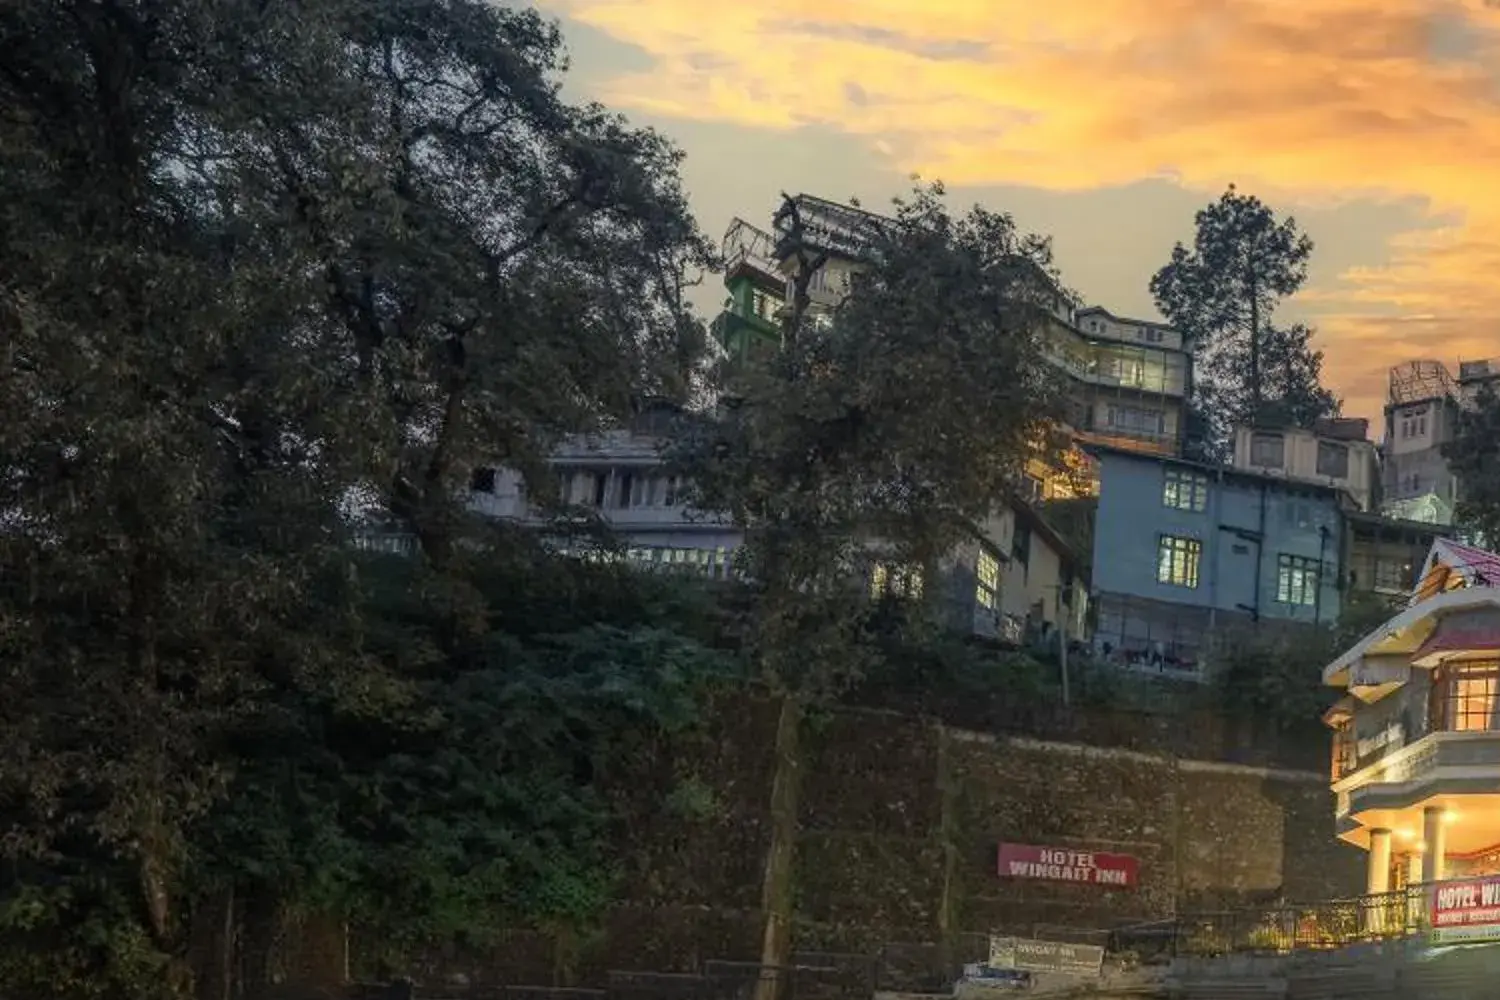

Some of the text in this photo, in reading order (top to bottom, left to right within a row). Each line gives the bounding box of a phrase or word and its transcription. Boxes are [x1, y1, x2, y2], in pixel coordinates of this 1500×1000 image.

[1040, 849, 1096, 868] HOTEL
[1009, 861, 1127, 884] WINGAIT INN
[1438, 886, 1477, 909] HOTEL
